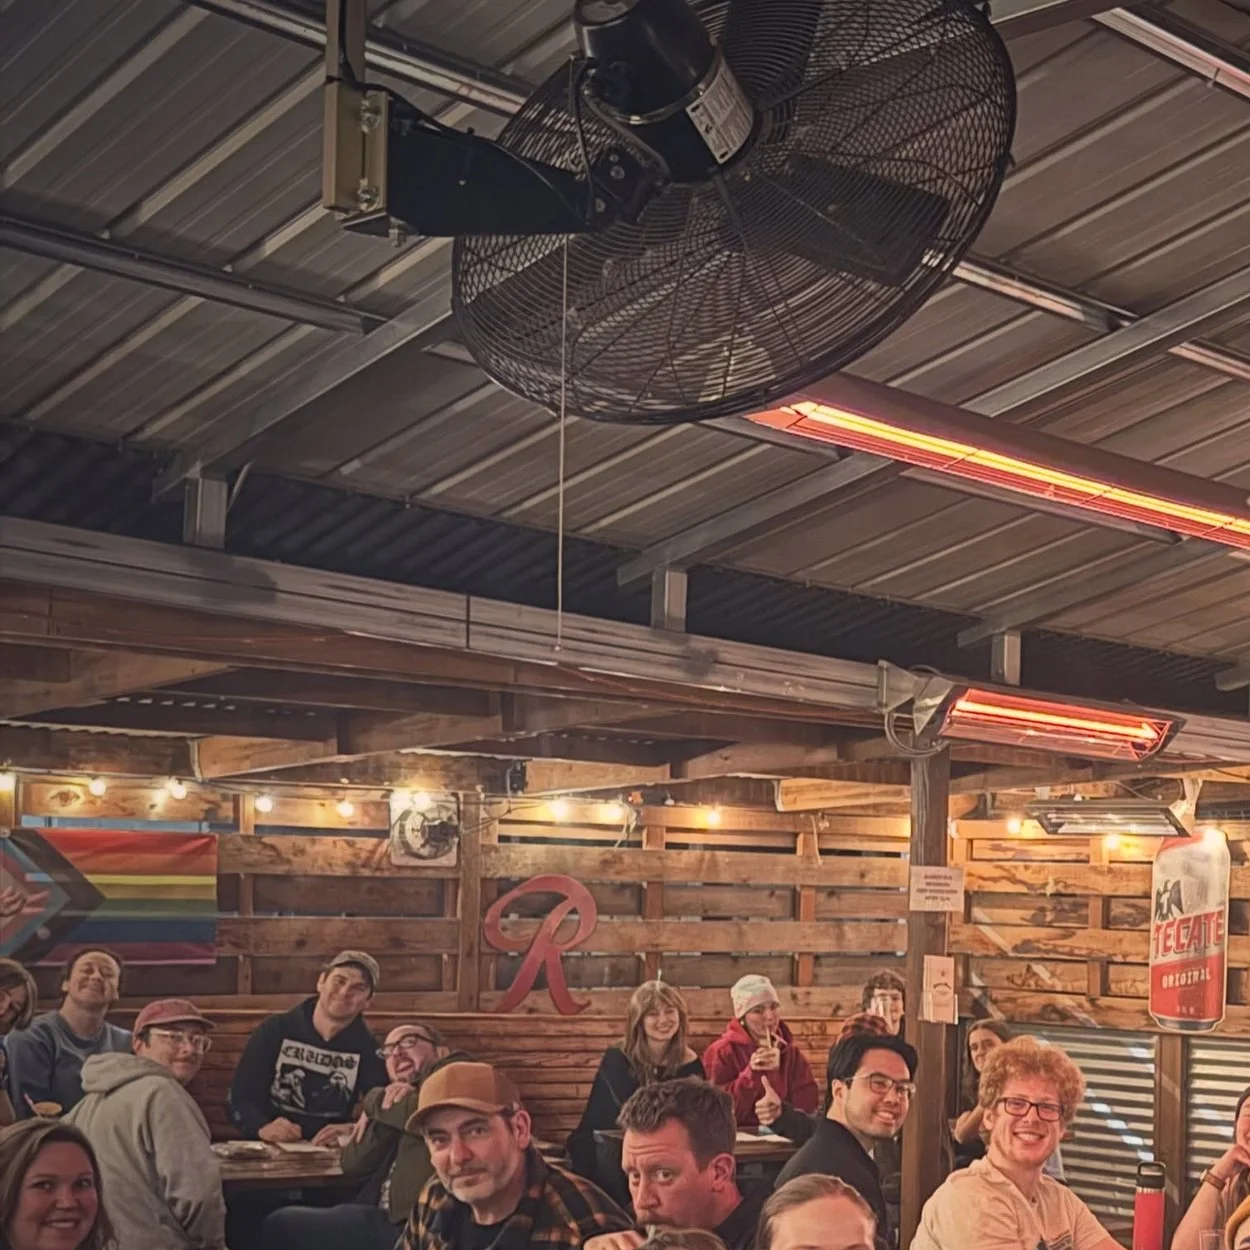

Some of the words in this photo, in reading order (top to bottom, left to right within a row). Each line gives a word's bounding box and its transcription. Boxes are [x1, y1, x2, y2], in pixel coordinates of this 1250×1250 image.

[484, 874, 597, 1014] R
[1154, 908, 1224, 958] TECATE
[1162, 967, 1211, 989] ORIGINAL
[282, 1045, 358, 1070] CRUDOS
